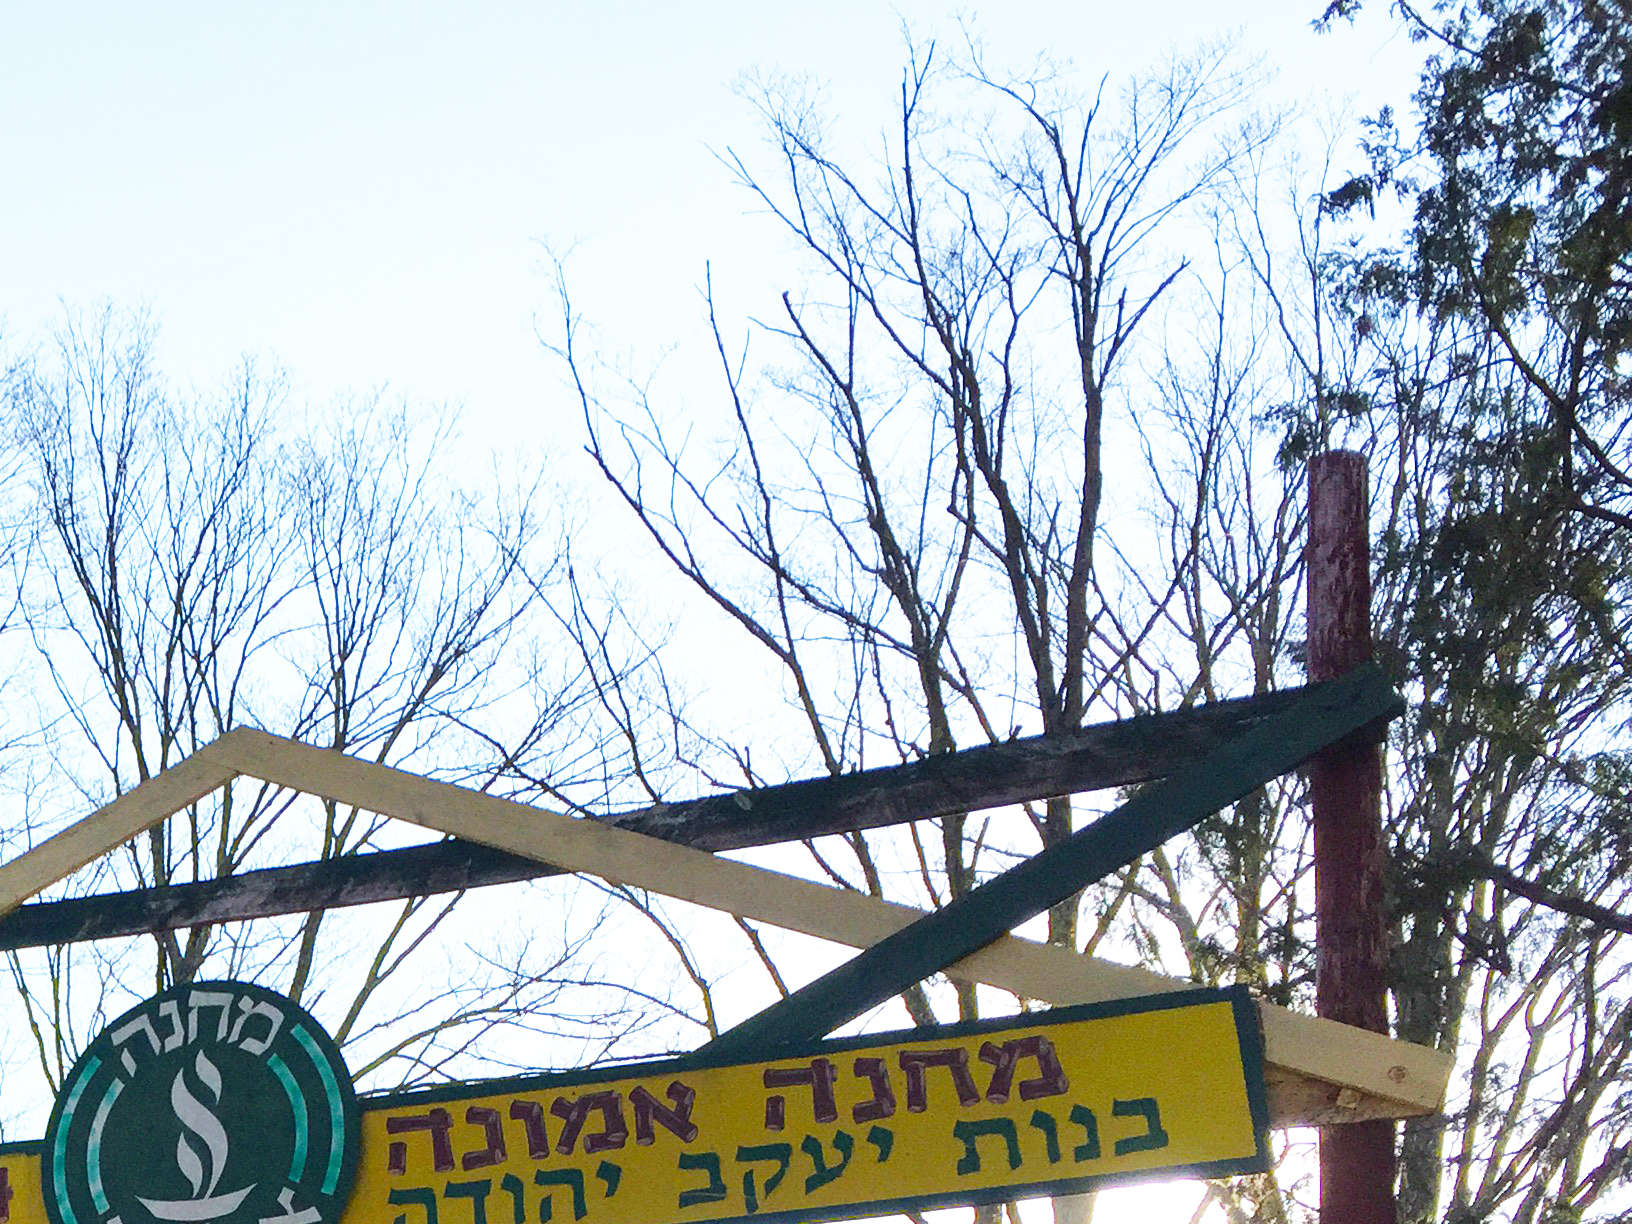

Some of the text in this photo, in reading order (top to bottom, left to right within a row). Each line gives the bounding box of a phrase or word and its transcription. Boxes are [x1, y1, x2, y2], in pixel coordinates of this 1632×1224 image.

[110, 990, 284, 1078] מחנה
[387, 1035, 1070, 1175] מחנה אמונה
[956, 1096, 1169, 1176] בנות
[677, 1126, 895, 1215] יעקב
